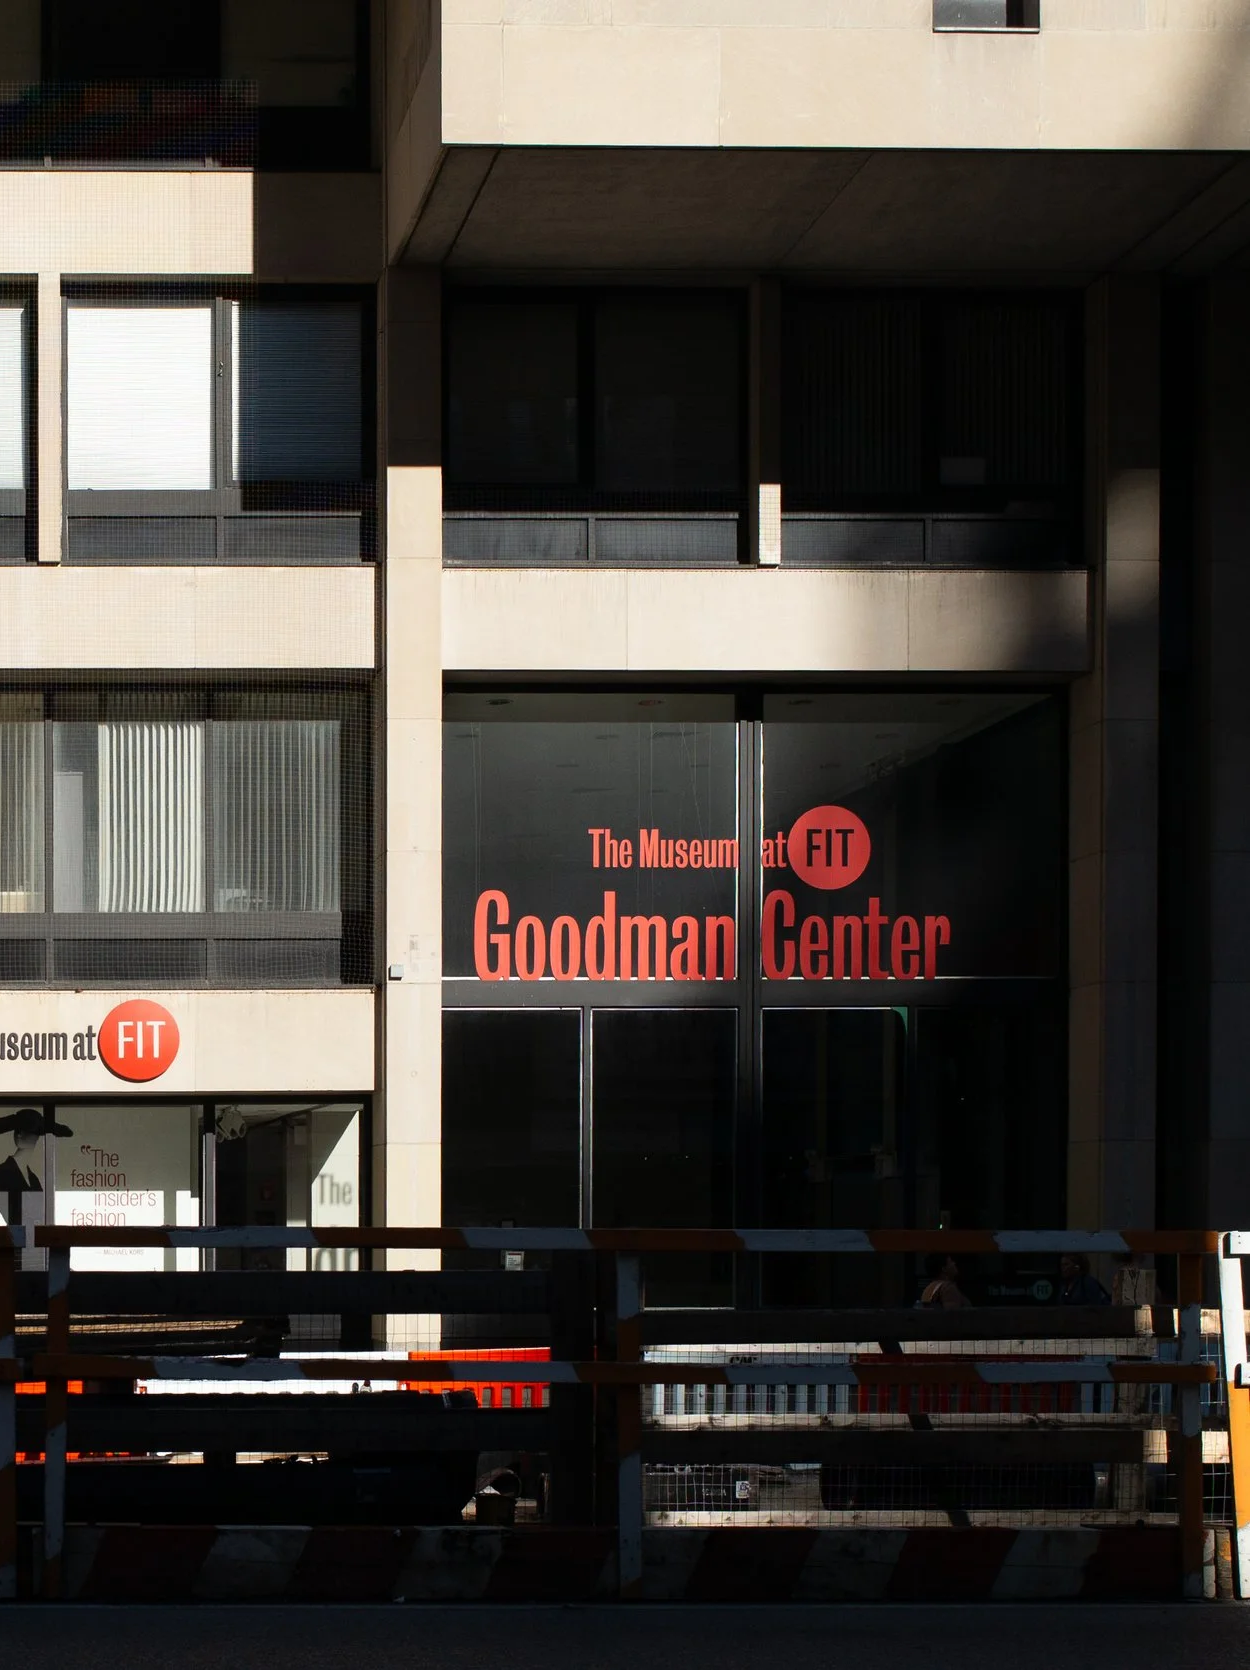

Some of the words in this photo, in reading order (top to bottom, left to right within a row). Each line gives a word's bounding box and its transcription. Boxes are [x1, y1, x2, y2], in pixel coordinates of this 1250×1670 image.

[588, 828, 633, 868] The
[639, 828, 739, 868] Museum
[762, 832, 788, 868] at
[806, 828, 854, 867] FIT
[474, 889, 736, 980] Goodman
[763, 889, 951, 981] Center
[73, 1025, 97, 1061] at
[118, 1021, 166, 1058] FIT
[71, 1169, 126, 1187] fashion
[319, 1174, 352, 1205] The
[71, 1209, 126, 1227] fashion
